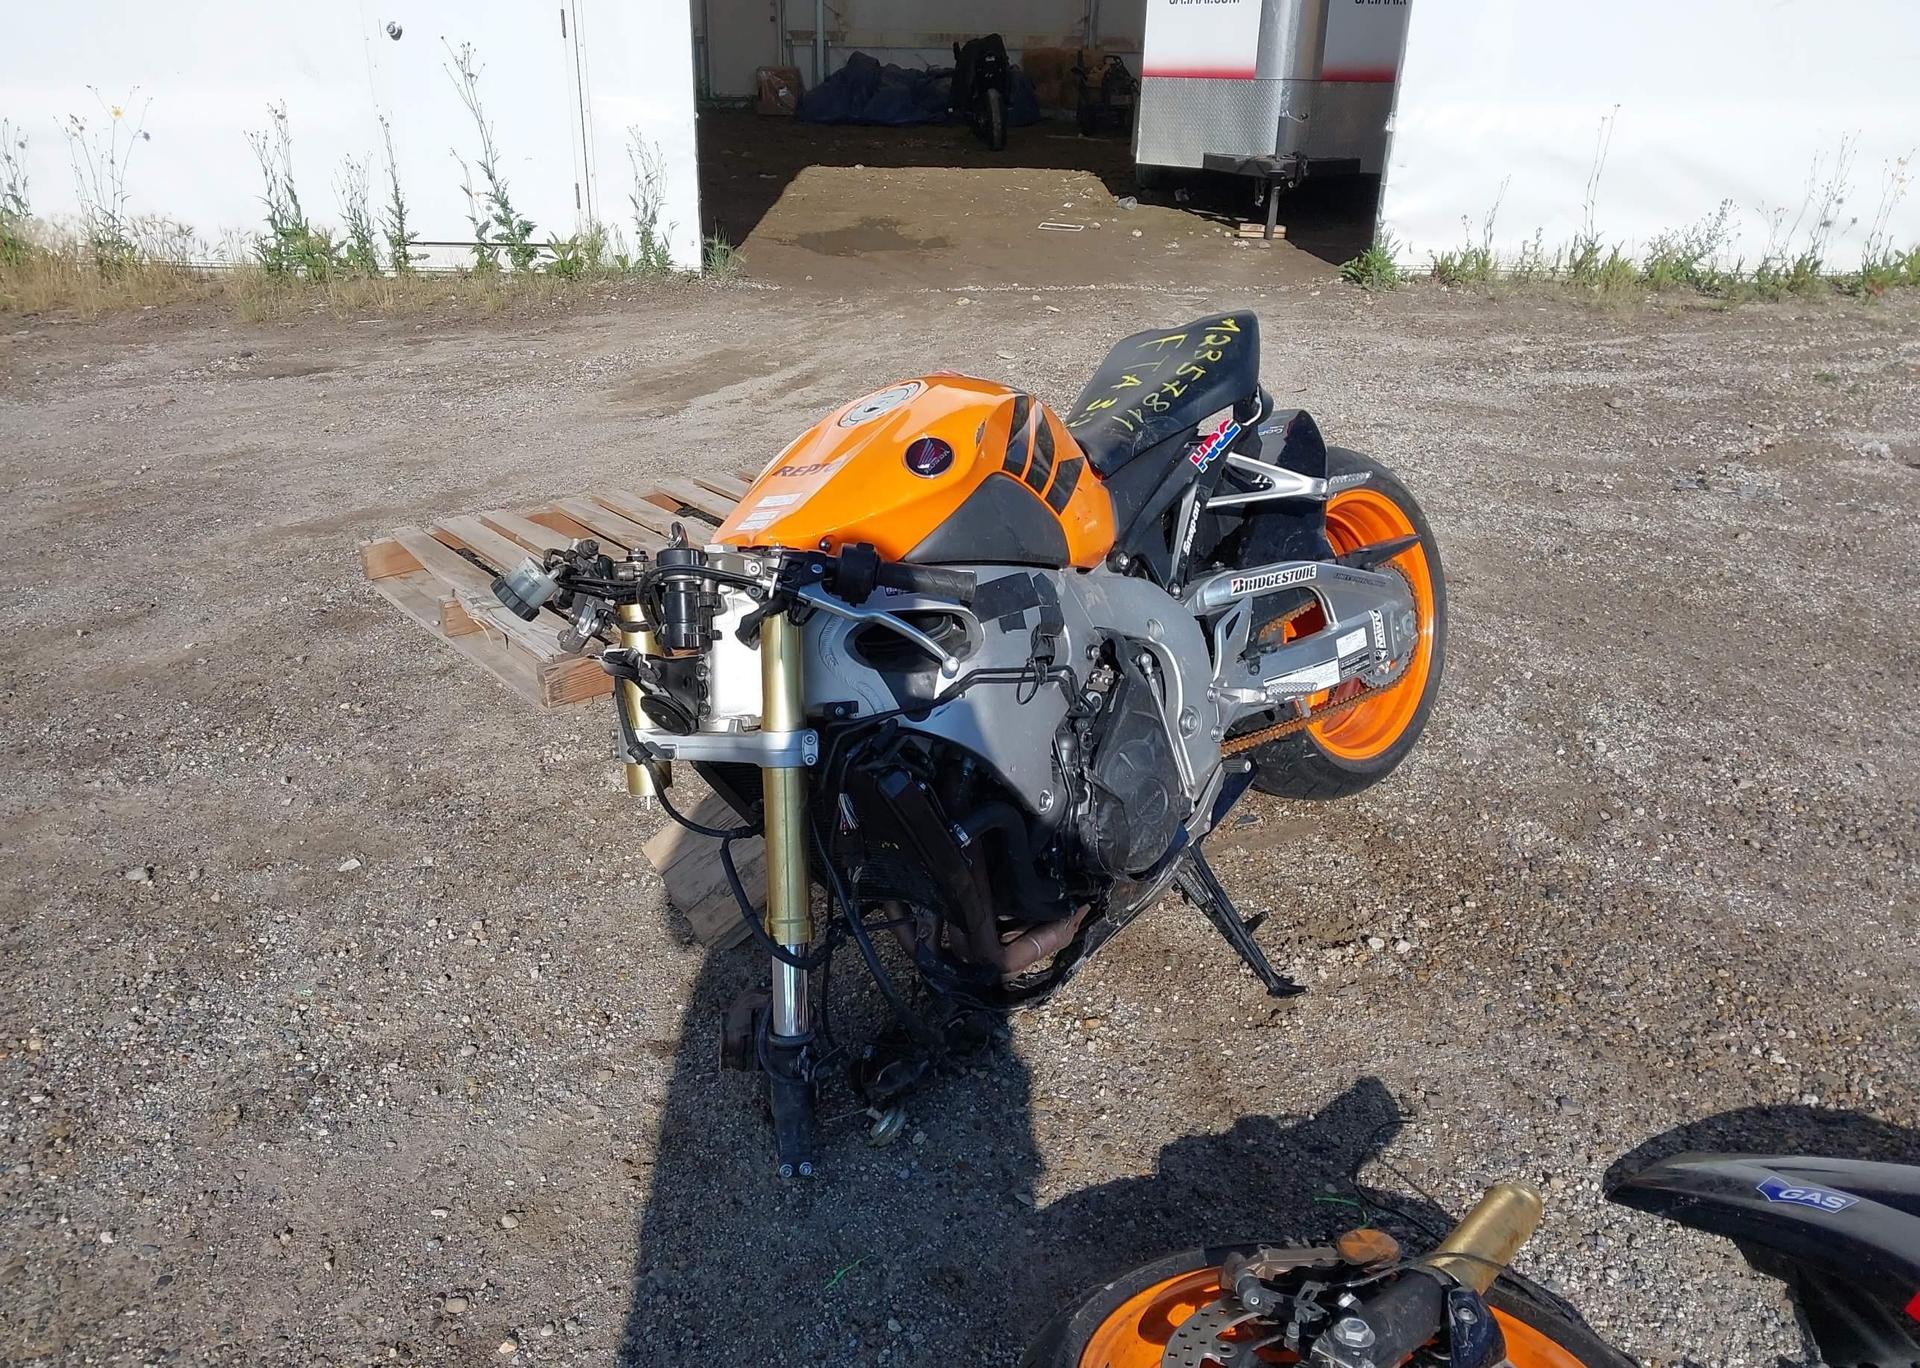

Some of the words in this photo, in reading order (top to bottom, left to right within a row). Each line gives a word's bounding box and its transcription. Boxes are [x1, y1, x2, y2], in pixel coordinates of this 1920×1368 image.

[1190, 419, 1241, 473] HRC
[1182, 500, 1201, 556] Snap-on
[1232, 566, 1315, 594] BRIDGESTONE
[1779, 1189, 1846, 1208] GAS
